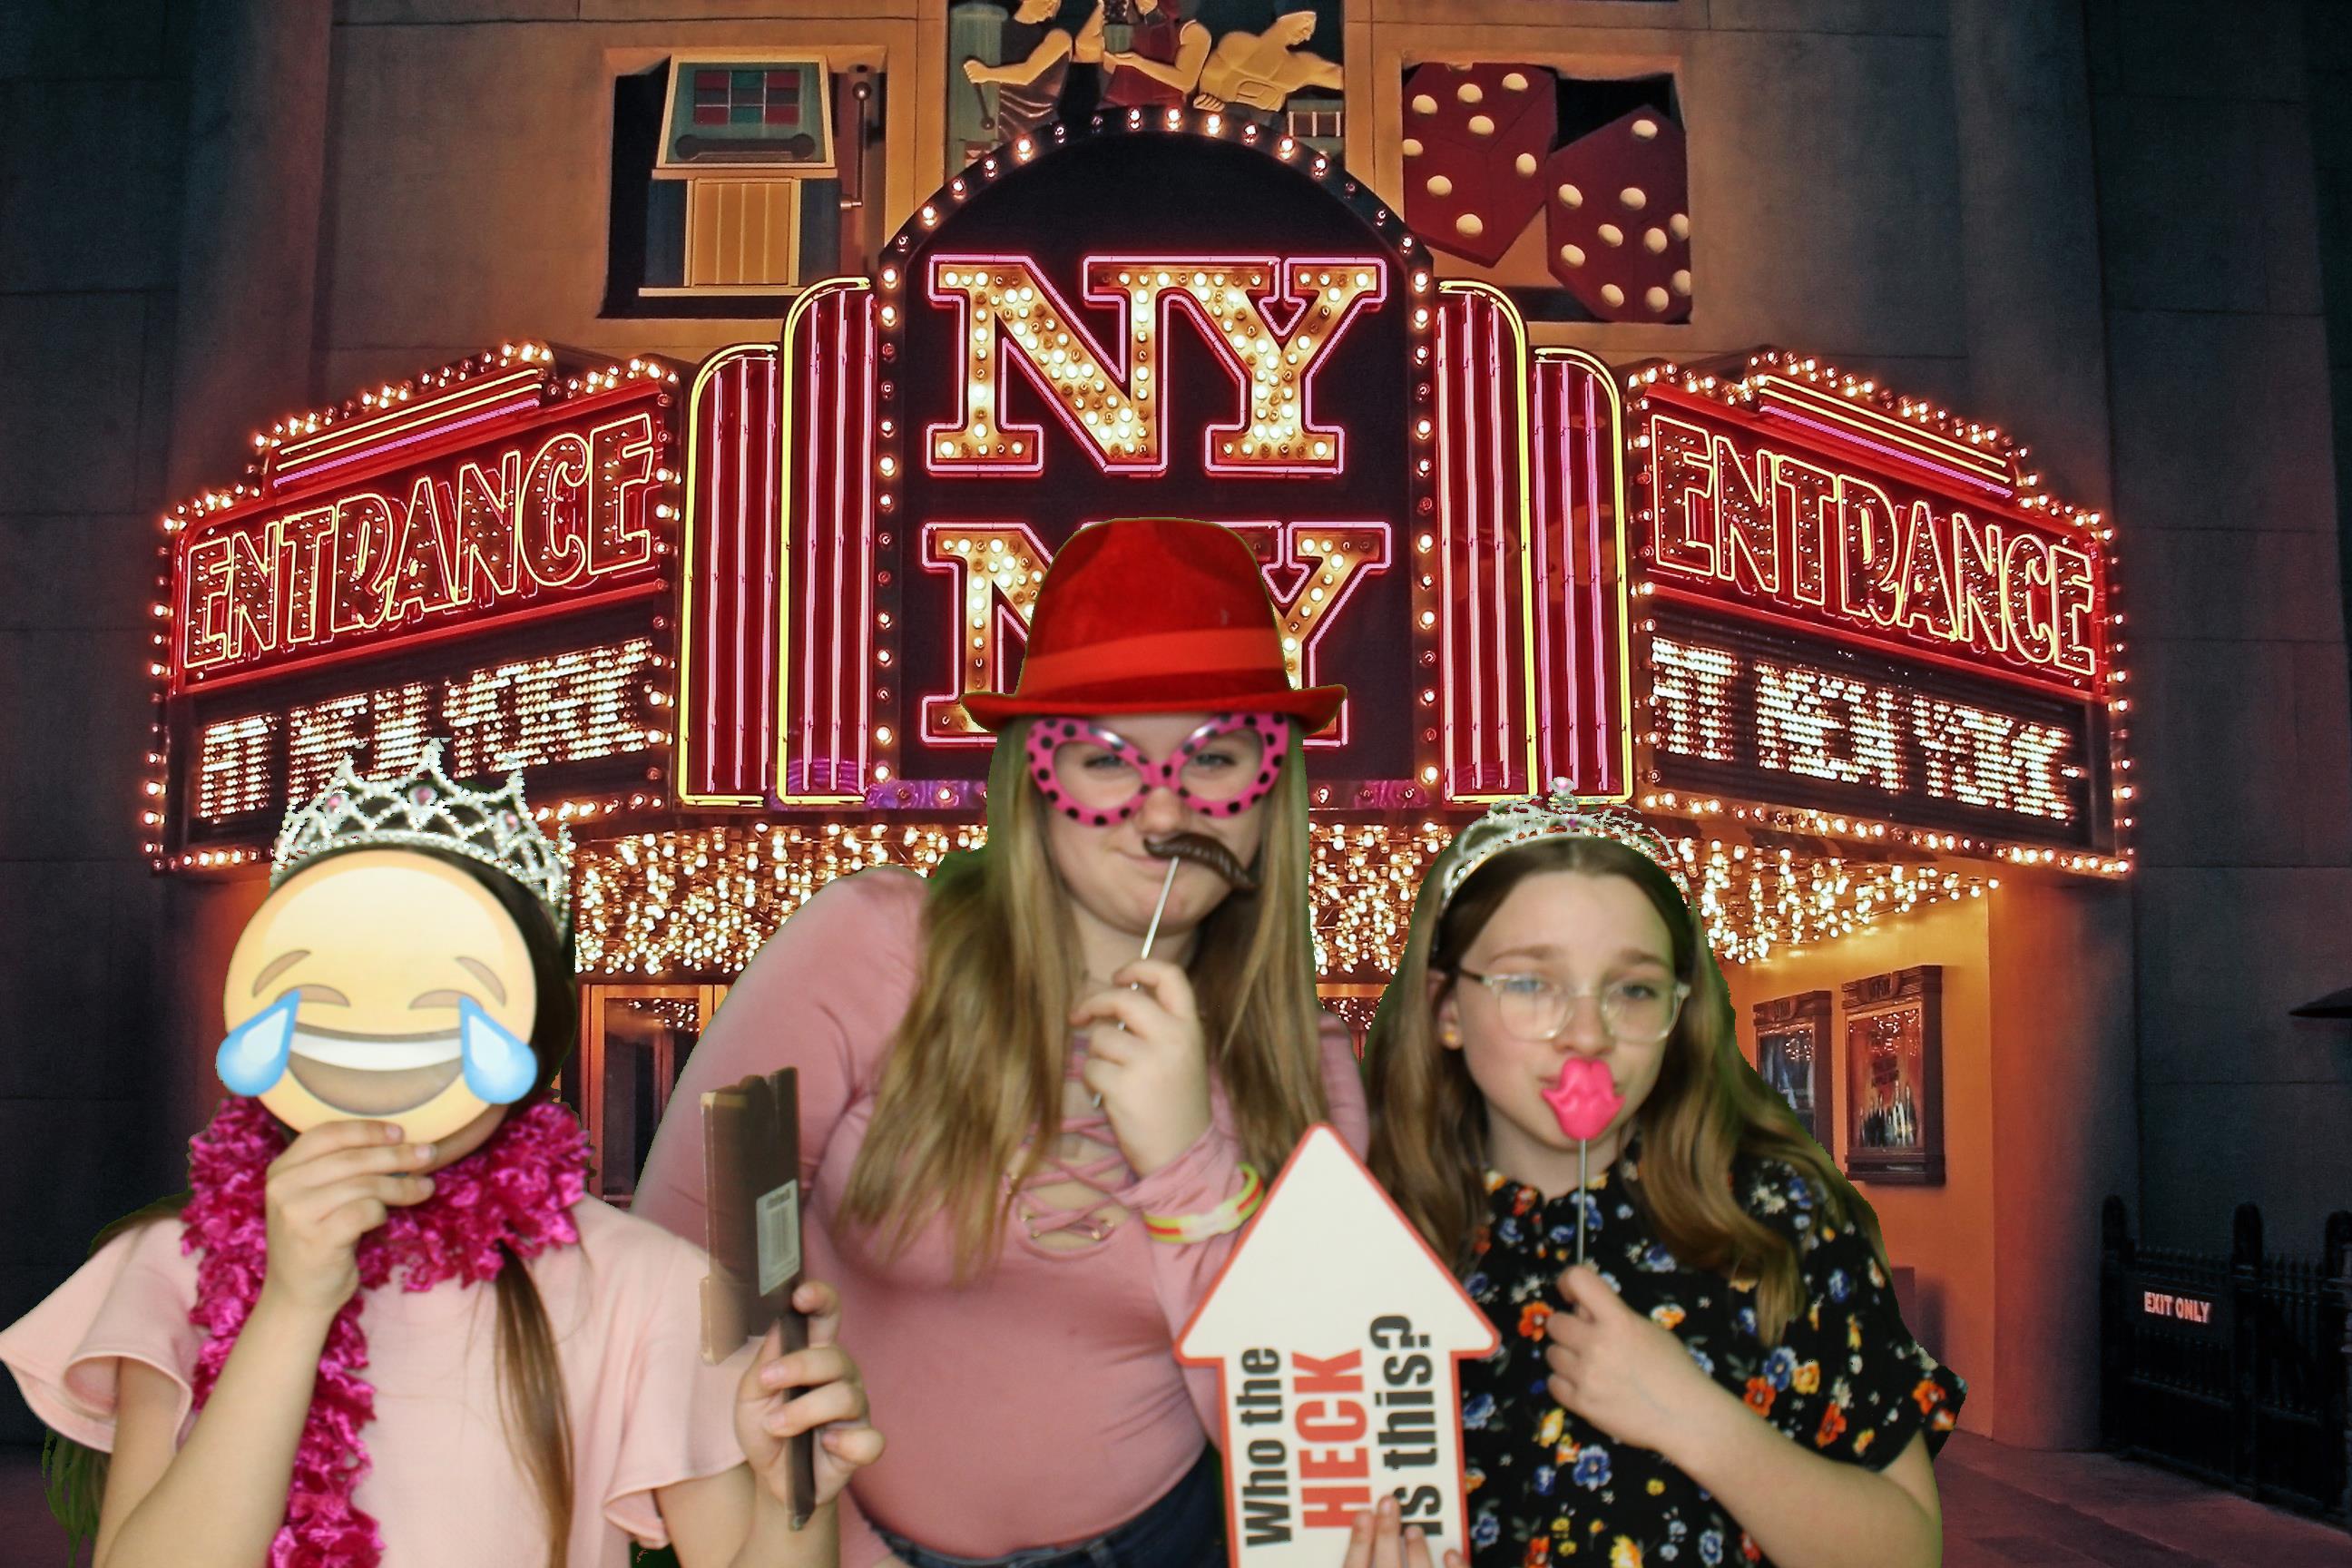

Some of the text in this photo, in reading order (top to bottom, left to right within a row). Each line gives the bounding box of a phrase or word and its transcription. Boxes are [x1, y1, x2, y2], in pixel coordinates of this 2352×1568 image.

[927, 255, 1387, 475] NY
[183, 413, 653, 669] ENTRANCE
[1651, 415, 2096, 675] ENTRANCE
[1370, 1314, 1438, 1470] this?
[2144, 1291, 2212, 1324] EXIT ONLY
[1236, 1348, 1293, 1547] Who the
[1291, 1349, 1372, 1528] HECK
